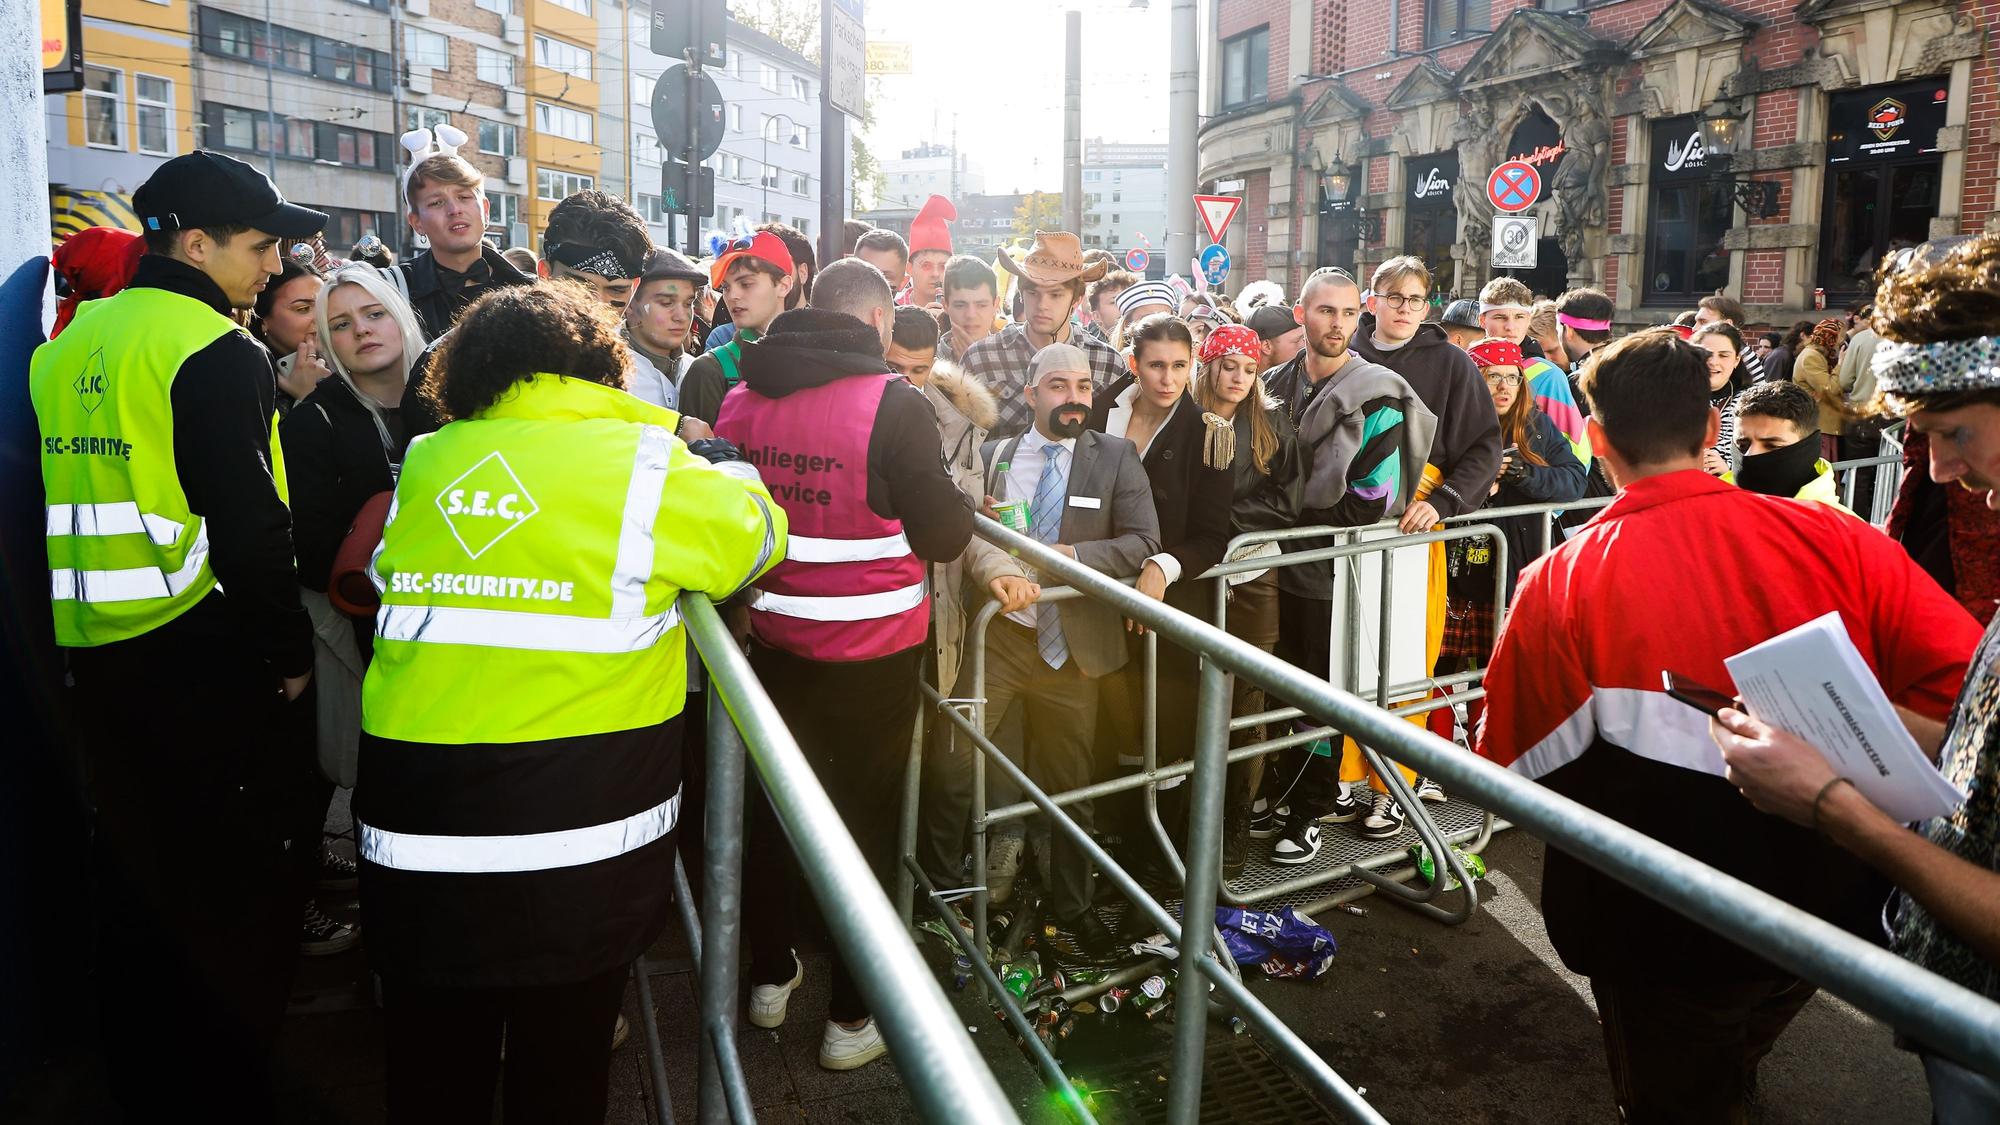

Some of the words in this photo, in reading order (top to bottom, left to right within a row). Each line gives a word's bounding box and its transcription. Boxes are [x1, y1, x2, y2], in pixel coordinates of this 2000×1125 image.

[1684, 160, 1707, 168] KÖLSC
[1506, 230, 1524, 245] 30
[738, 442, 844, 475] Anlieger-
[447, 489, 525, 520] S.E.C.
[768, 481, 832, 506] rvice
[391, 571, 575, 602] SEC-SECURITY.DE
[1822, 680, 1890, 777] Untermietvertrag
